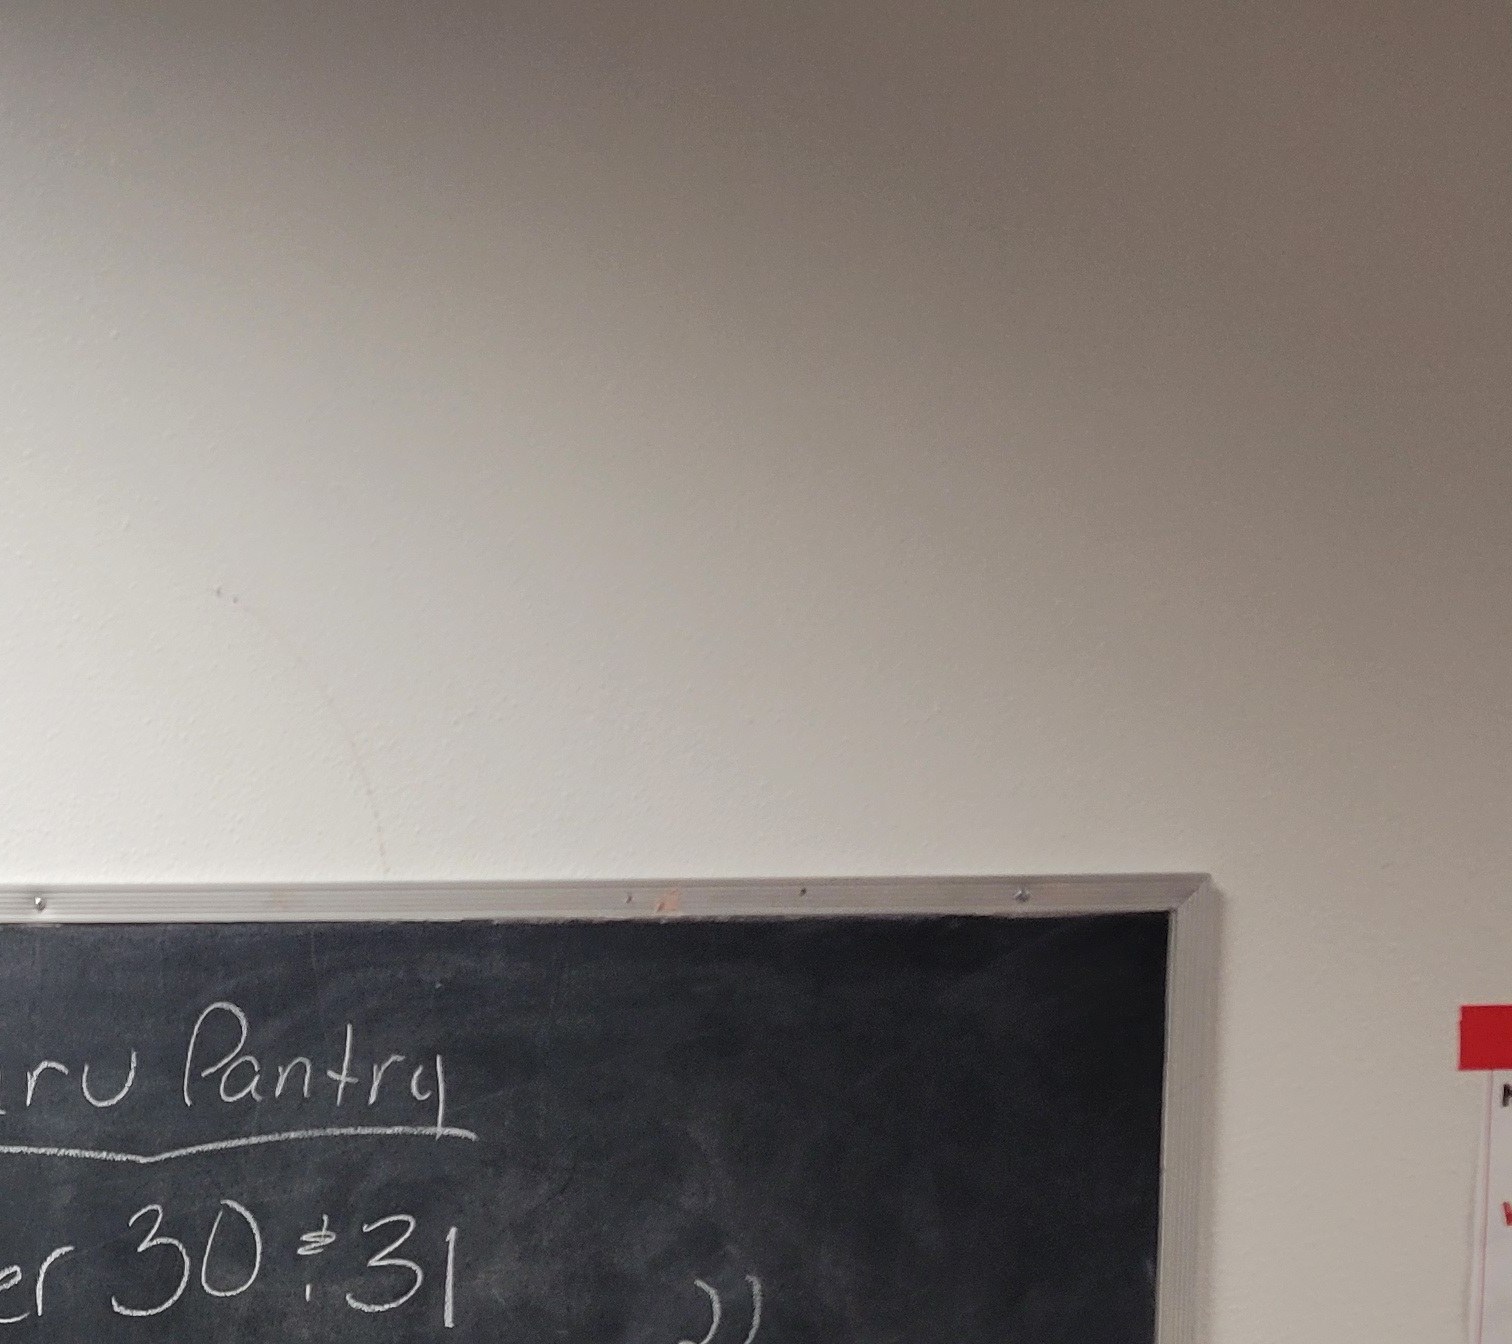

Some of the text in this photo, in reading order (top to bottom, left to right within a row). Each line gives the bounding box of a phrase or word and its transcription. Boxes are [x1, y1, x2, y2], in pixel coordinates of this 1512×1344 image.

[182, 1001, 448, 1138] Pantry
[110, 1199, 264, 1317] 30
[345, 1214, 459, 1329] 31
